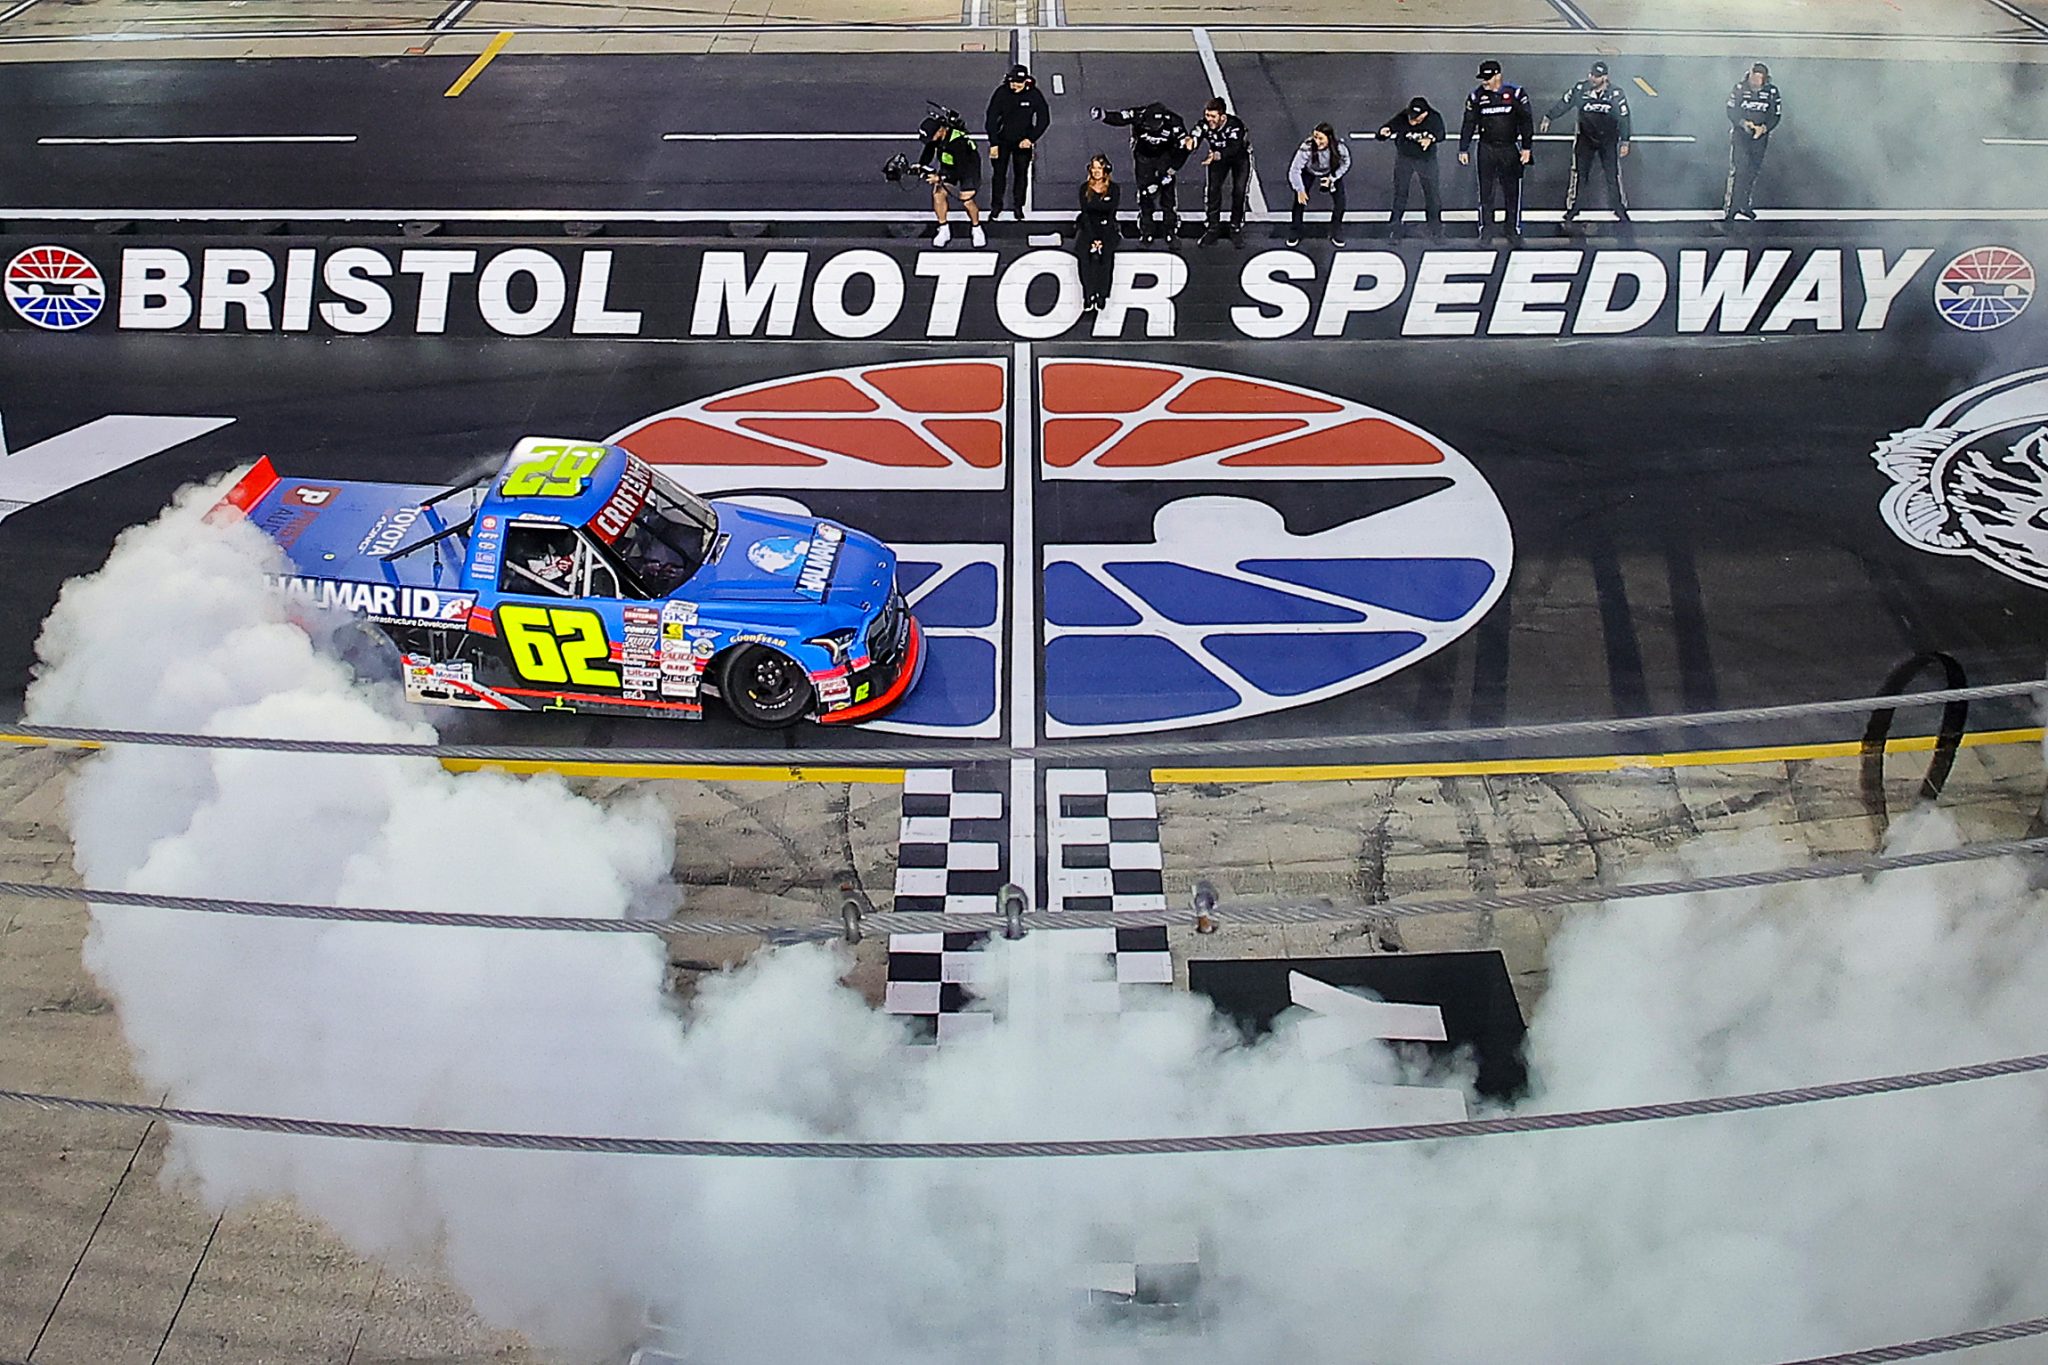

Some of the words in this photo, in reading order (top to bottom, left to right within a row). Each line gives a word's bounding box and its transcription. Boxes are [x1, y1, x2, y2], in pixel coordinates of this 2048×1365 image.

[118, 247, 642, 335] BRISTOL
[690, 250, 1189, 339] MOTOR
[1230, 248, 1935, 339] SPEEDWAY
[366, 505, 424, 556] TOYOTA
[799, 540, 839, 593] HALMAR
[367, 615, 417, 627] Infrastructure
[418, 619, 467, 631] Development
[402, 588, 440, 619] ID
[664, 611, 697, 622] SKF
[499, 604, 621, 688] 62
[729, 632, 788, 648] GOODYEAR
